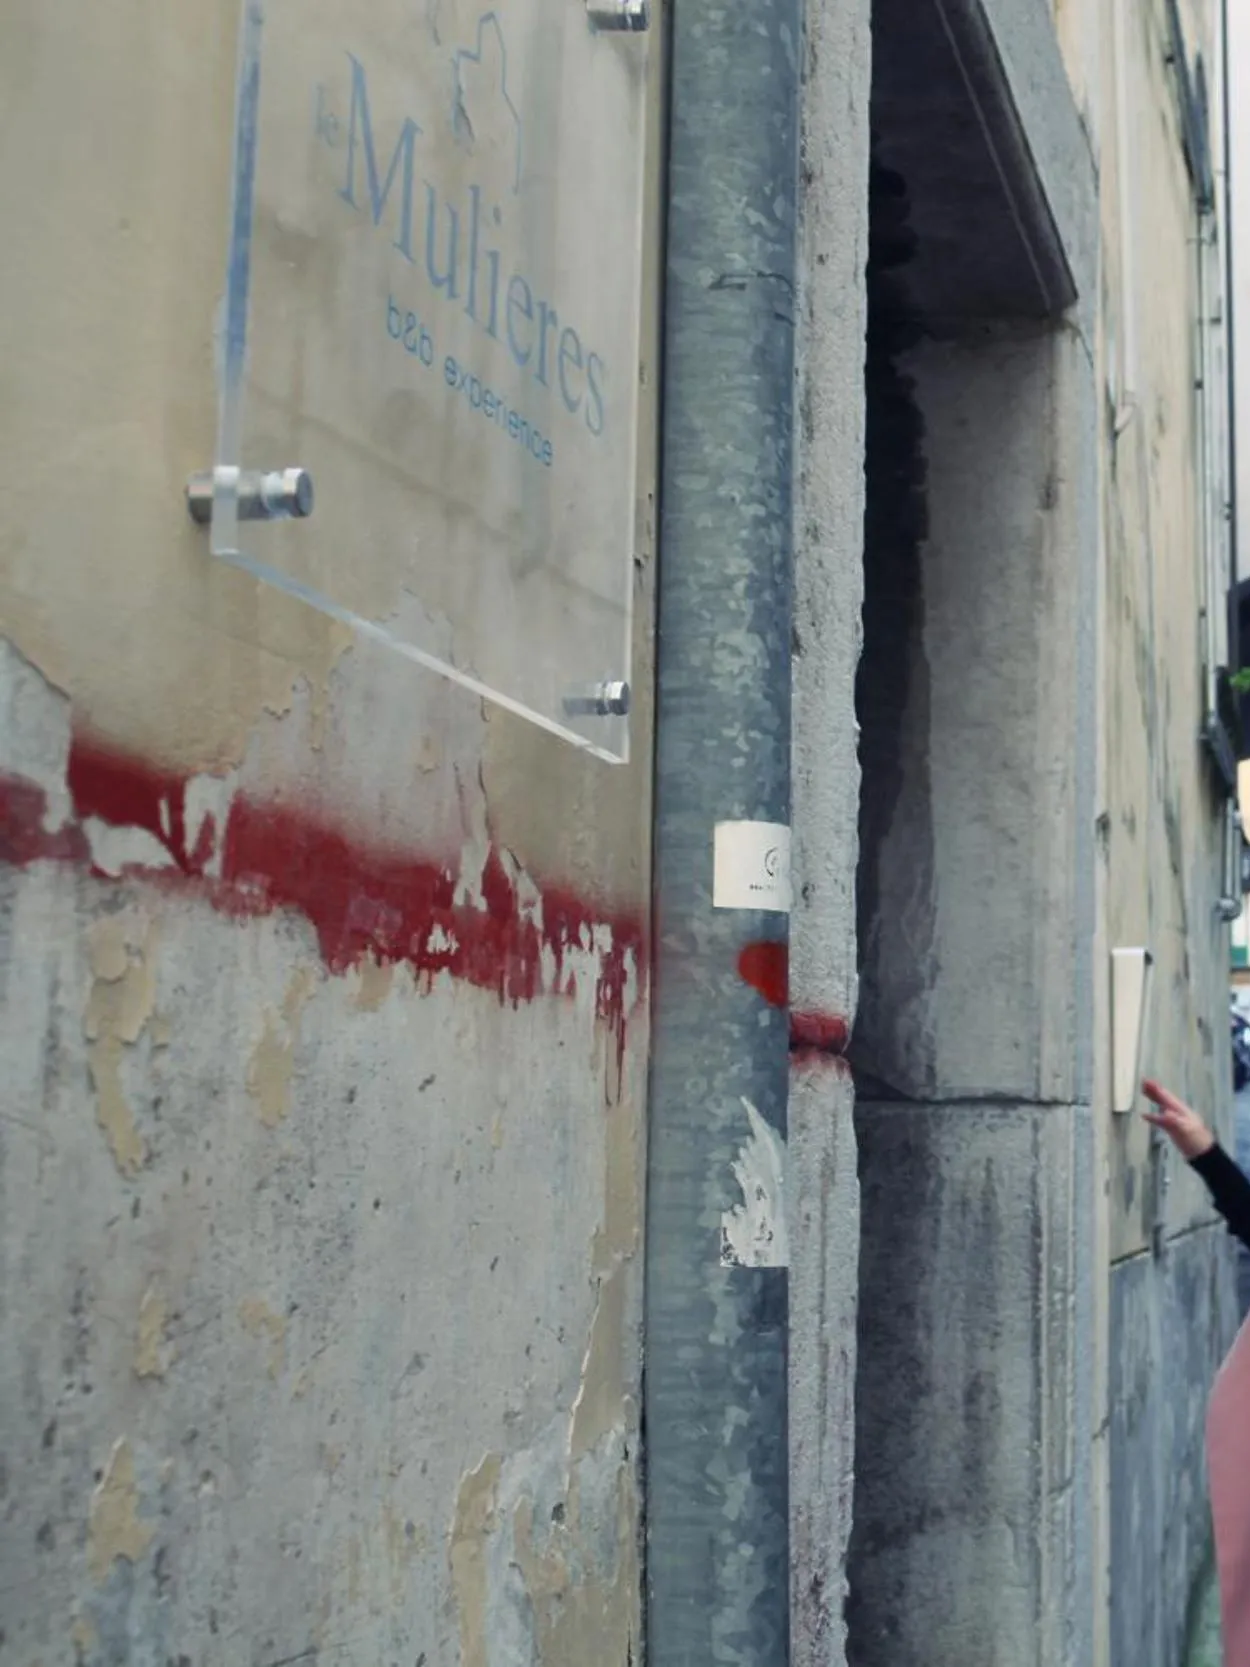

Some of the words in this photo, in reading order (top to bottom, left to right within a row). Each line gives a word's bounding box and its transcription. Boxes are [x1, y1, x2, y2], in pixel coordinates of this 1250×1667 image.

[338, 51, 604, 437] Mulieres
[387, 295, 434, 367] b&b
[445, 356, 552, 467] experience
